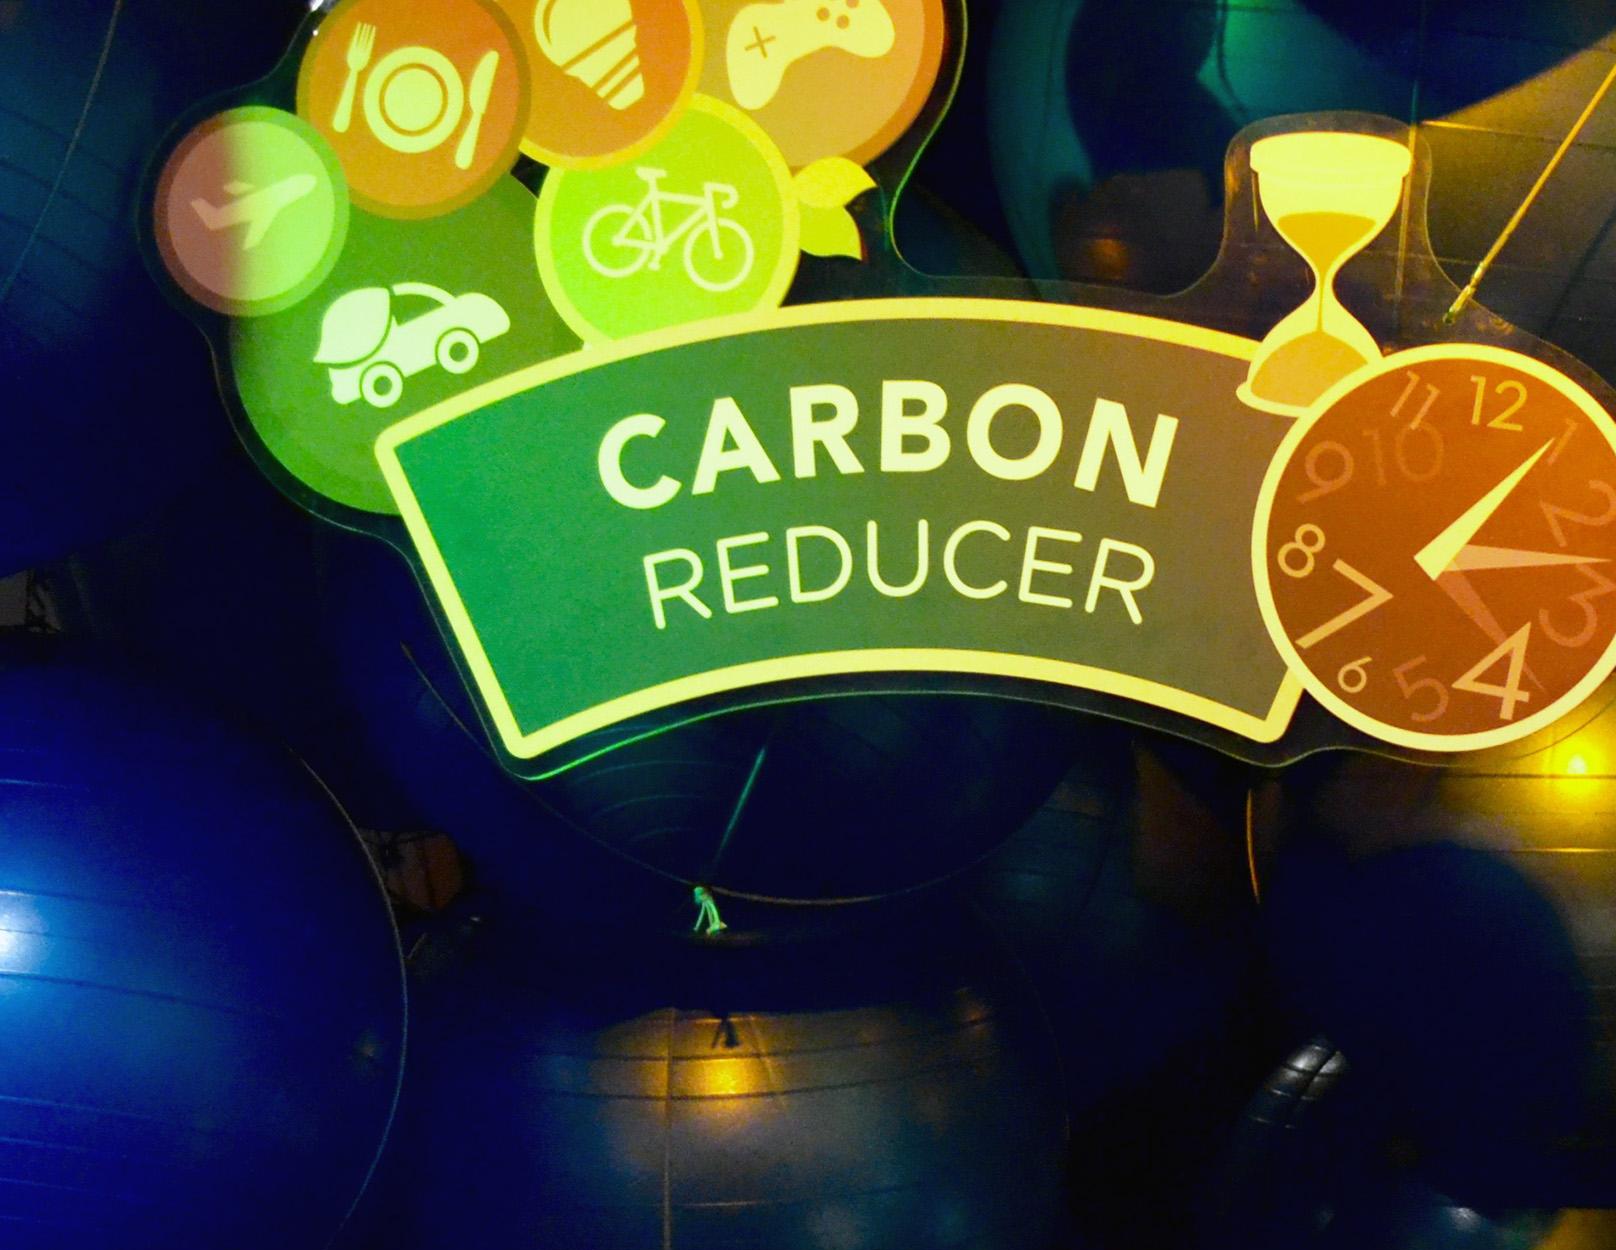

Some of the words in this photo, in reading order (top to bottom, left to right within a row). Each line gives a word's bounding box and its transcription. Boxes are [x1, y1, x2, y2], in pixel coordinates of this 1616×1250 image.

[1390, 369, 1440, 430] 11
[1470, 374, 1528, 431] 12
[598, 379, 1179, 510] CARBON
[1296, 440, 1355, 504] 9
[1545, 418, 1579, 466] 1
[642, 518, 1156, 631] REDUCER
[1277, 523, 1326, 579] 8
[1295, 558, 1394, 650] 7
[1337, 655, 1373, 693] 6
[1392, 655, 1450, 723] 5
[1452, 621, 1532, 720] 4
